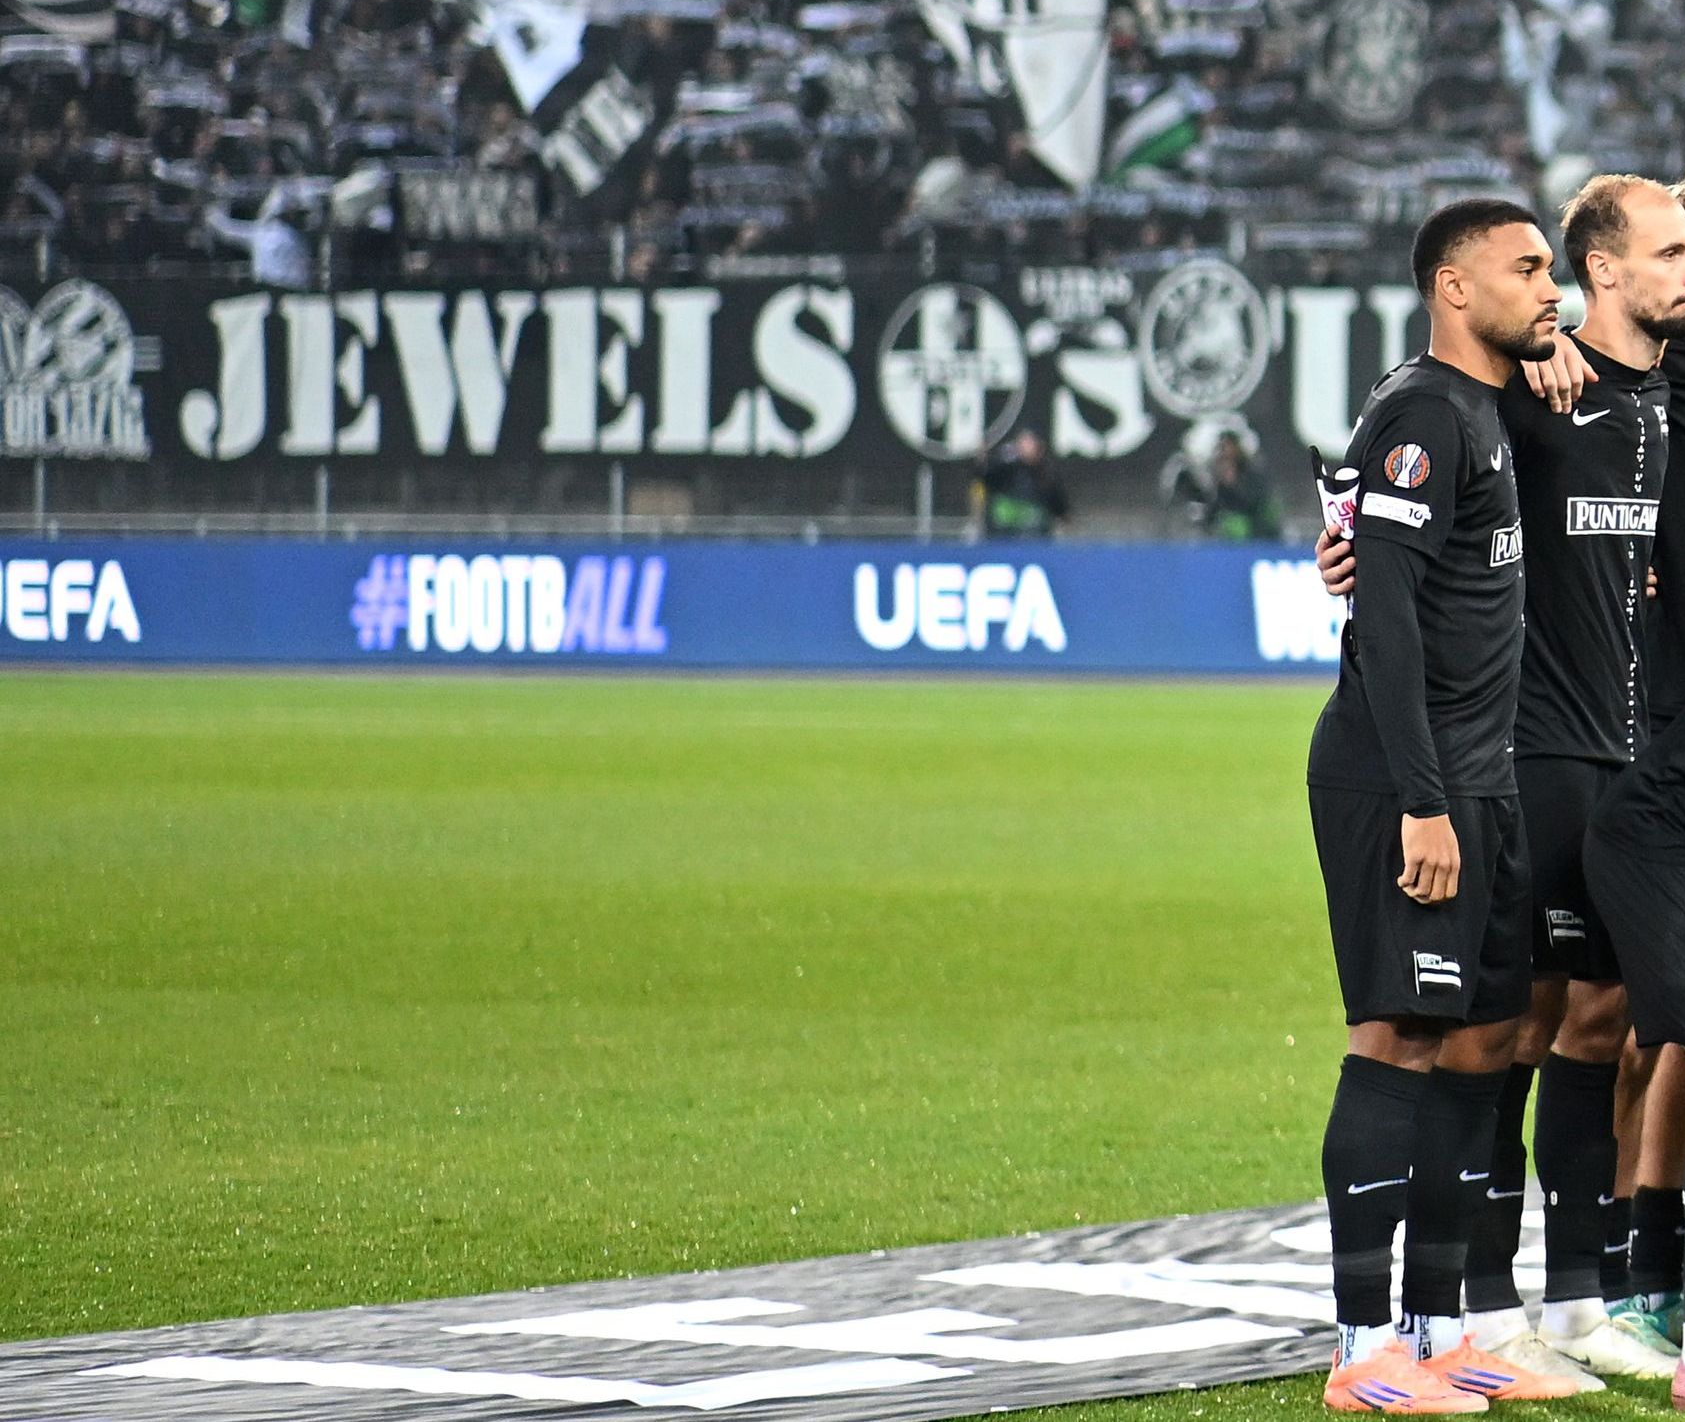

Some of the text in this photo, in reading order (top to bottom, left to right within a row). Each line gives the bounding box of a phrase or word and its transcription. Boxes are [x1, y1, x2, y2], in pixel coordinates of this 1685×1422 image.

[180, 284, 856, 460] JEWELS
[0, 559, 141, 642] EFA
[350, 554, 670, 654] #FOOTBALL
[854, 562, 1069, 653] UEFA
